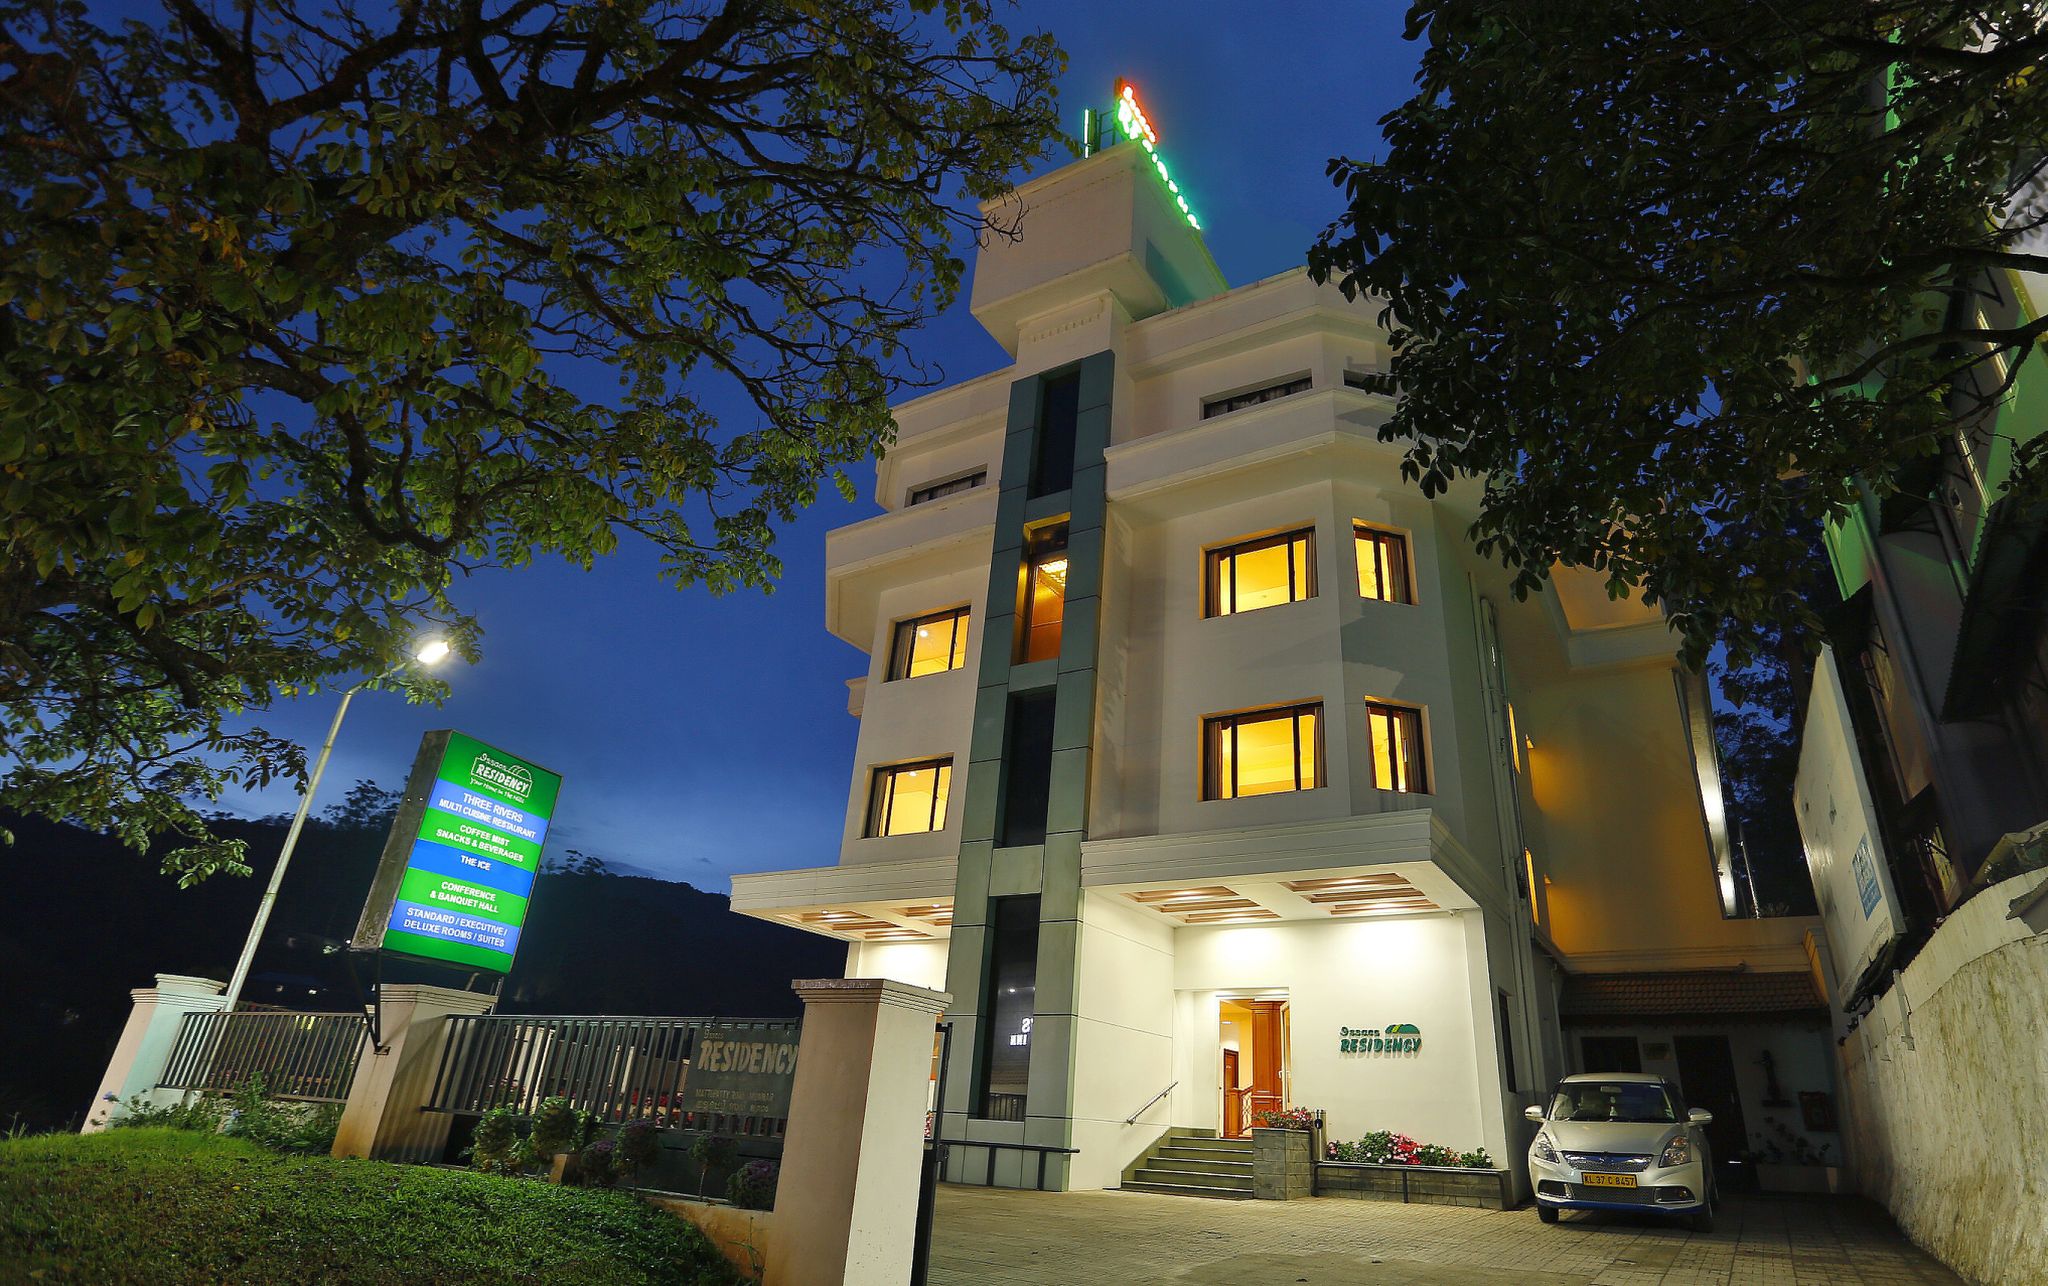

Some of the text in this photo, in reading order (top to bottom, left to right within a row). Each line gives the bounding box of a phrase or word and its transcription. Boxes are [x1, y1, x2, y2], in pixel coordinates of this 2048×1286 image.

[475, 763, 529, 793] RESIDENCY
[439, 798, 537, 839] MULTI CUISINE RESTAURANT
[463, 792, 523, 823] THREE RIVERS
[436, 828, 524, 863] SNACKS & BEVERAGES
[460, 824, 510, 847] COFFEE MIST
[461, 855, 491, 871] THE ICE
[429, 890, 499, 913] & BANQUET HALL
[441, 881, 496, 901] CONFERENCE
[404, 919, 441, 934] DELUXE
[441, 927, 473, 940] ROOMS
[477, 934, 505, 948] SUITES
[407, 907, 455, 924] STANDARD
[460, 918, 504, 935] EXECUTIVE
[698, 1040, 799, 1075] RESIDENCY
[1340, 1038, 1422, 1053] RESIDENCY
[1584, 1175, 1595, 1184] KL
[1595, 1175, 1605, 1184] 37
[1607, 1176, 1613, 1184] C
